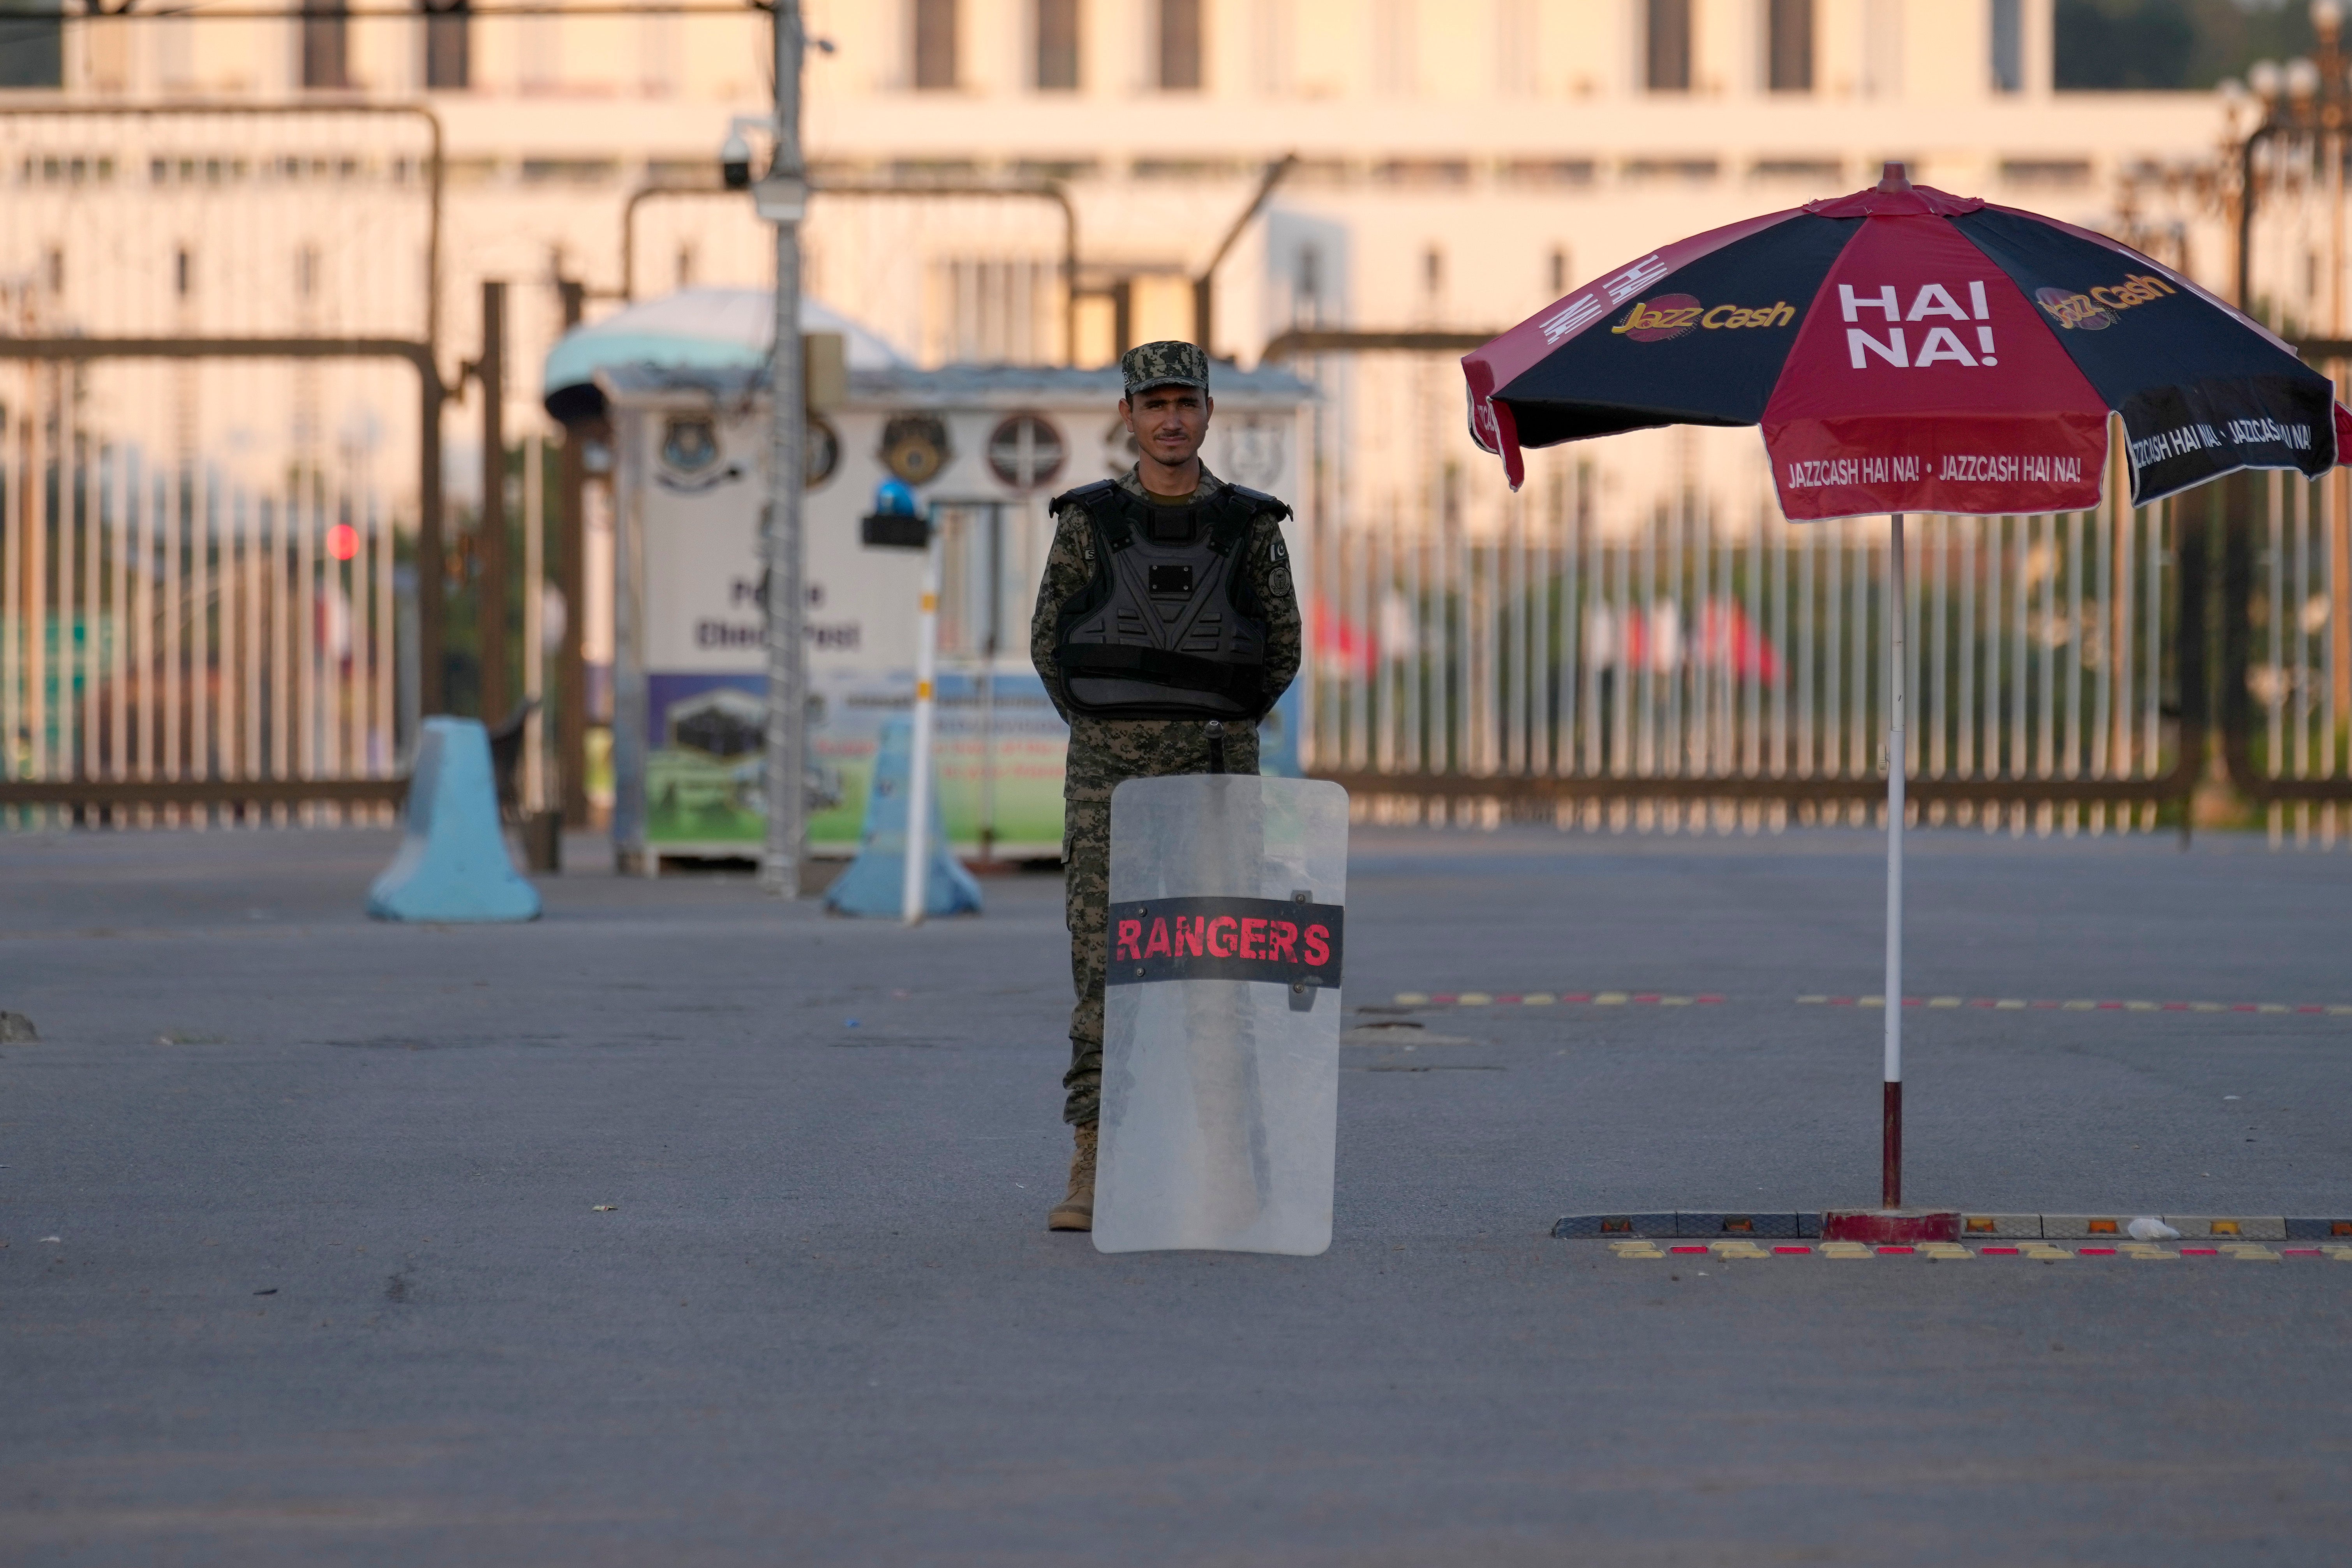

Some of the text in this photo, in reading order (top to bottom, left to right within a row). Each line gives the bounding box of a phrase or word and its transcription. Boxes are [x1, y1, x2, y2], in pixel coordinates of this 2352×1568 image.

[1603, 254, 1668, 305] HAI
[2089, 274, 2177, 309] Cash
[1701, 302, 1795, 329] Cash
[1839, 281, 1989, 322] HAI
[1847, 326, 1998, 369] NA!
[2169, 425, 2202, 455] HAI
[2197, 424, 2222, 448] NA!
[2228, 418, 2281, 444] JAZZCAS
[2291, 425, 2311, 450] NA!
[1789, 456, 2081, 489] JAZZCASH HAI NA! JAZZCASH HAI NA!
[1116, 916, 1330, 967] RANGERS
